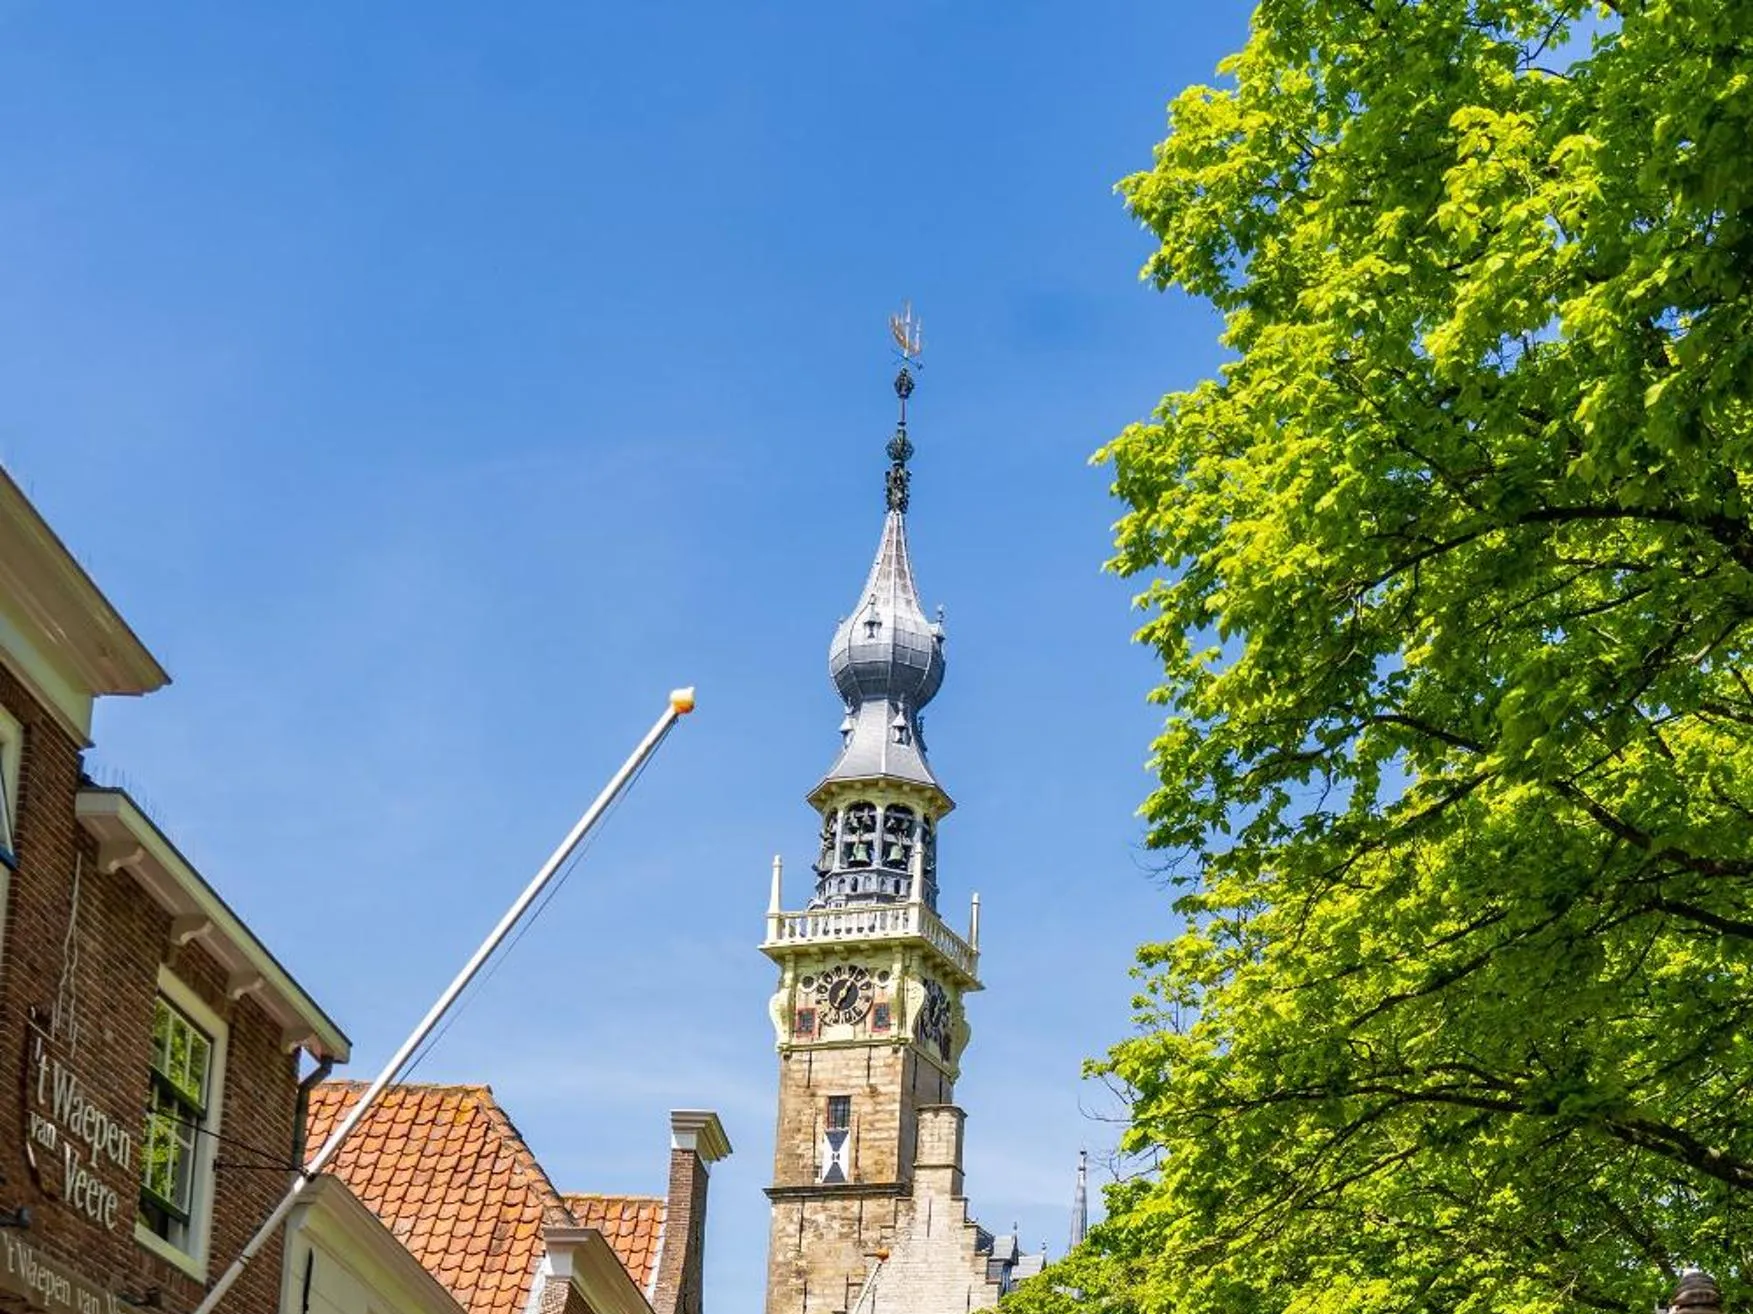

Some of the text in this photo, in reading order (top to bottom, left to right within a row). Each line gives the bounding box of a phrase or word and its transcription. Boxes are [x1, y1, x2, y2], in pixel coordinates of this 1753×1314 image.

[35, 1036, 131, 1170] 't Waepen
[30, 1111, 119, 1230] van Veere
[16, 1242, 71, 1306] Waepen
